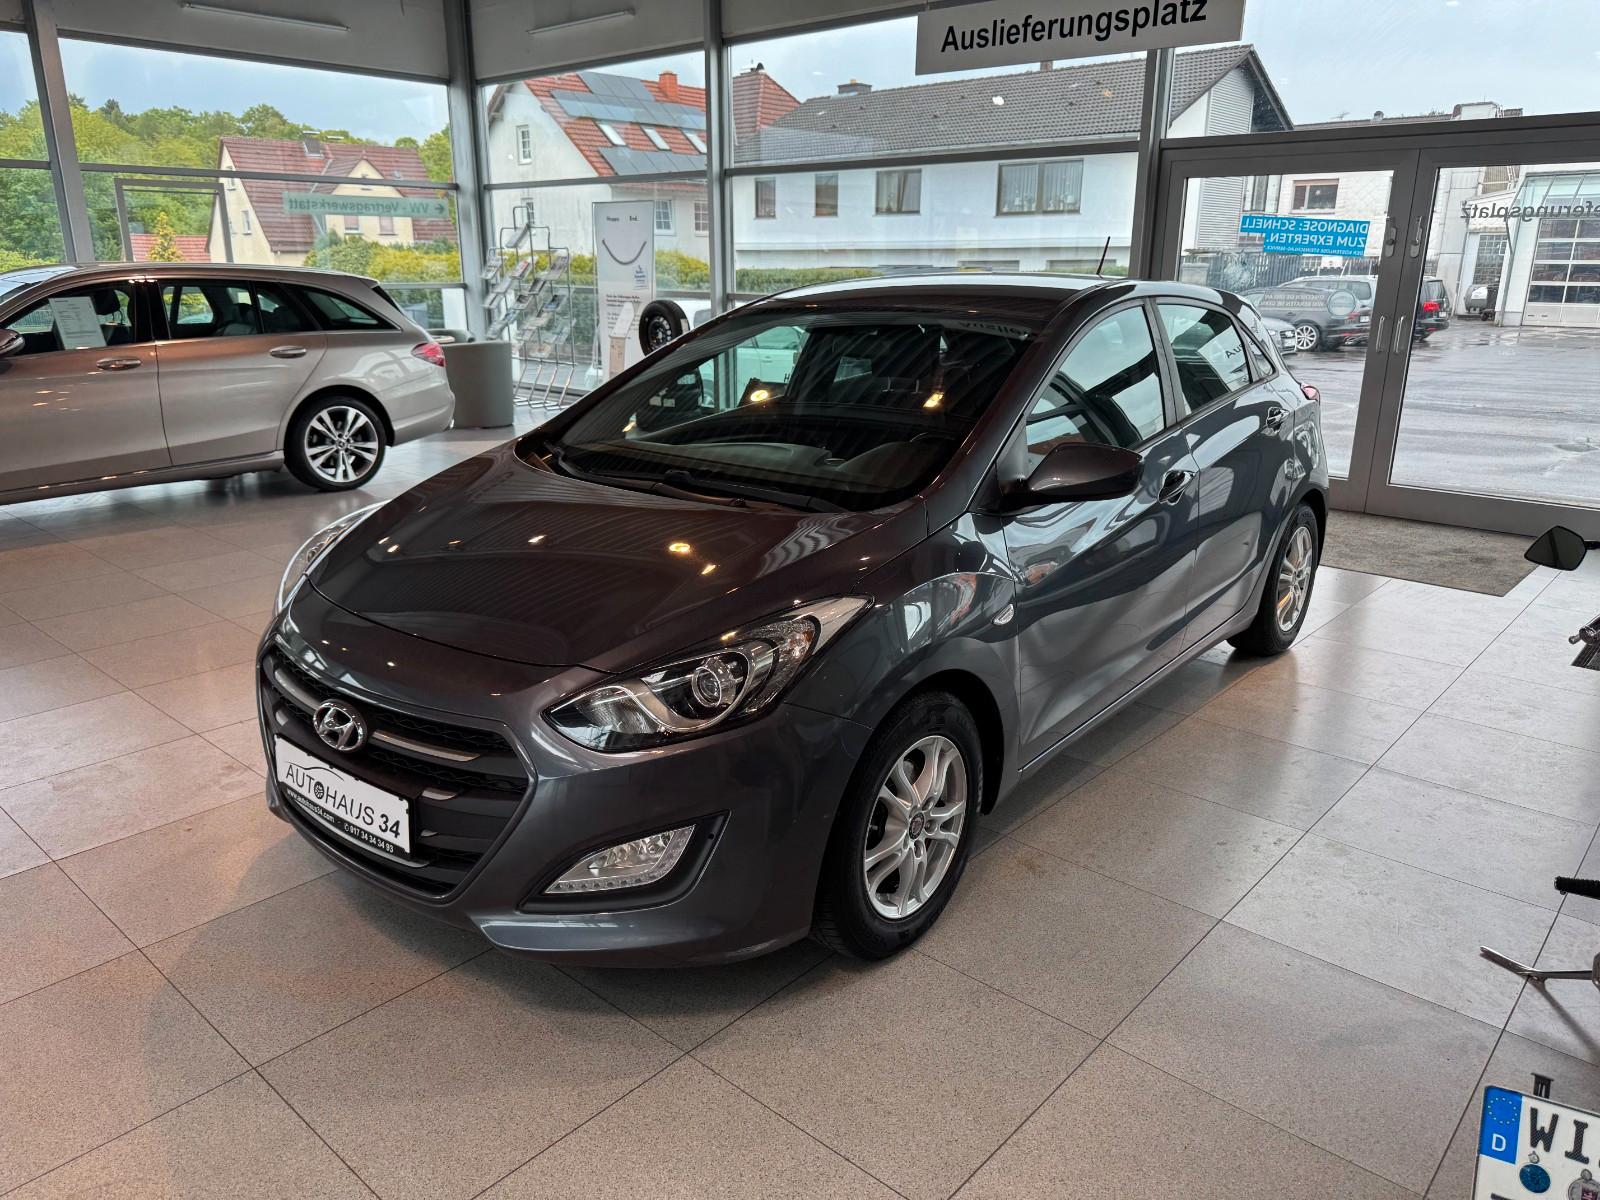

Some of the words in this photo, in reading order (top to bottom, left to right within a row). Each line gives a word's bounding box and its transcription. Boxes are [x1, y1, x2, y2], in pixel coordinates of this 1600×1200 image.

[941, 0, 1207, 53] Auslieferungsplatz
[286, 765, 374, 826] AUTOHAUS
[379, 813, 401, 839] 34
[1491, 1133, 1507, 1152] D
[1530, 1106, 1600, 1168] WI
